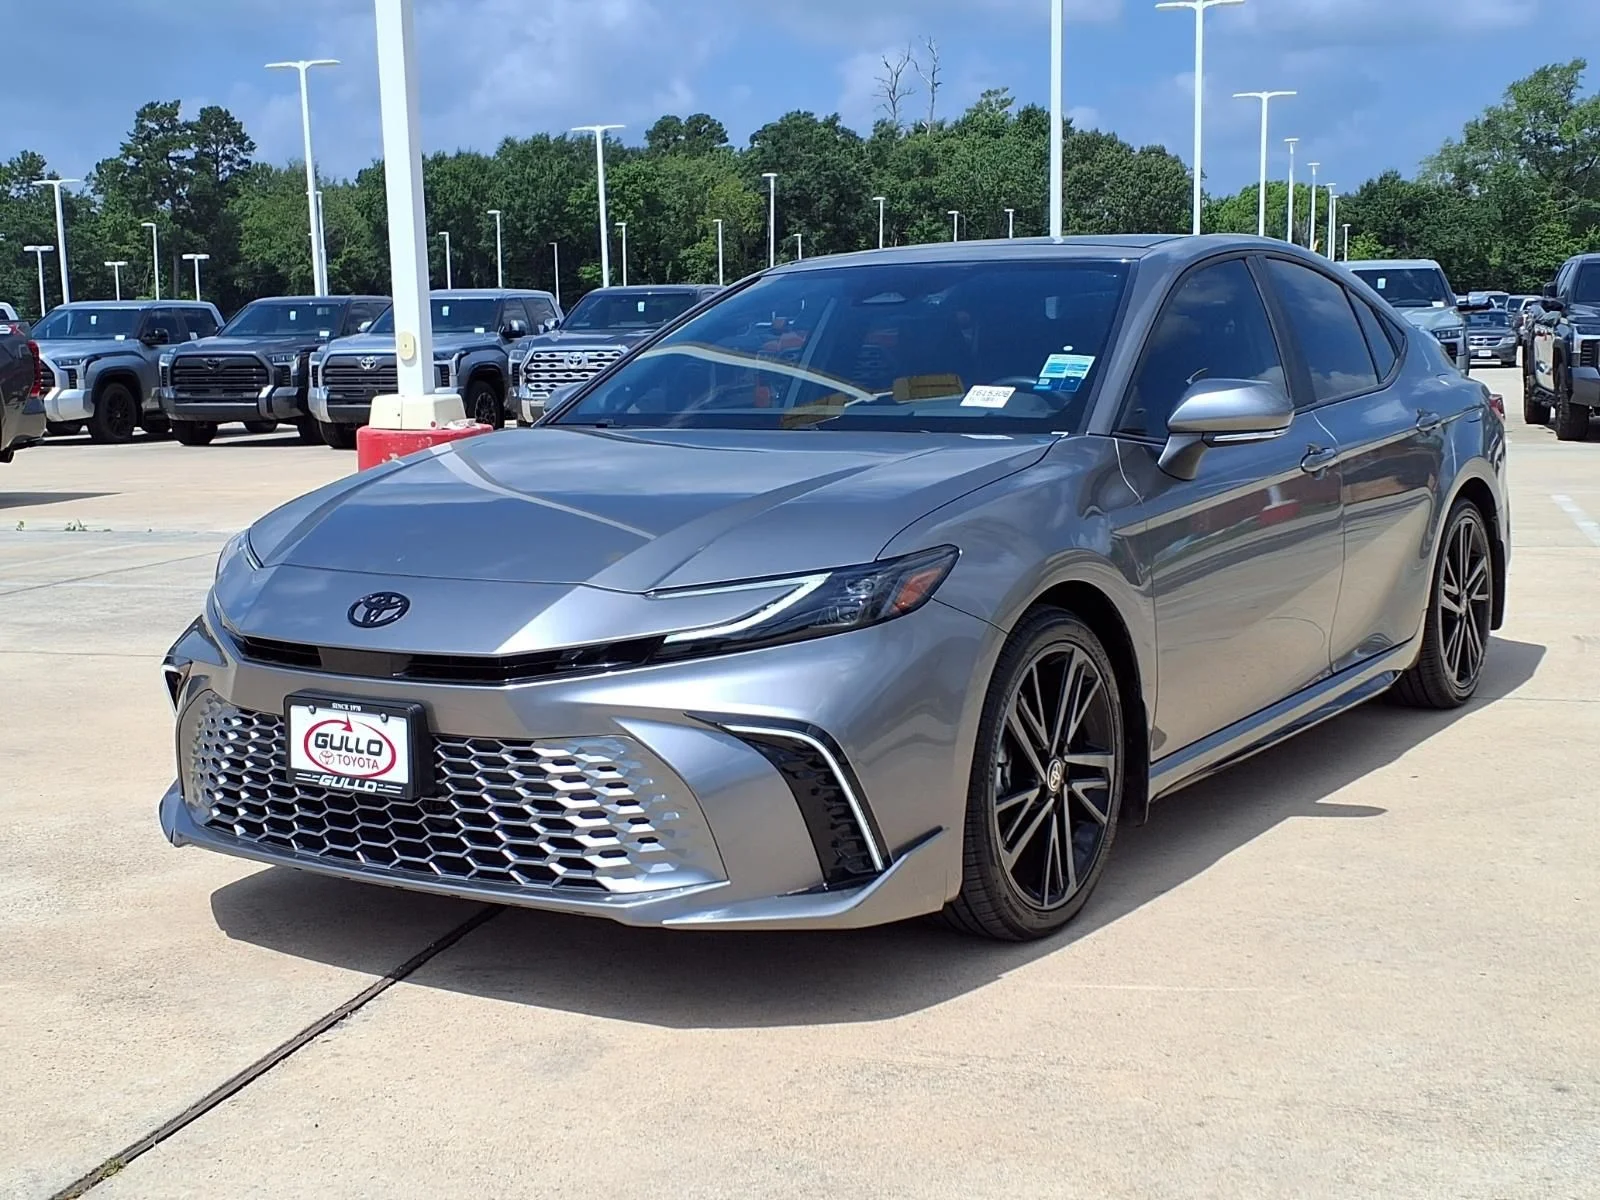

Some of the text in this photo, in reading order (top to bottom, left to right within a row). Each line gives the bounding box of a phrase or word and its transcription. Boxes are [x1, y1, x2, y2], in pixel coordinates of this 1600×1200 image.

[315, 732, 383, 756] GULLO
[337, 754, 379, 770] TOYOTA
[319, 774, 378, 793] GULLO
